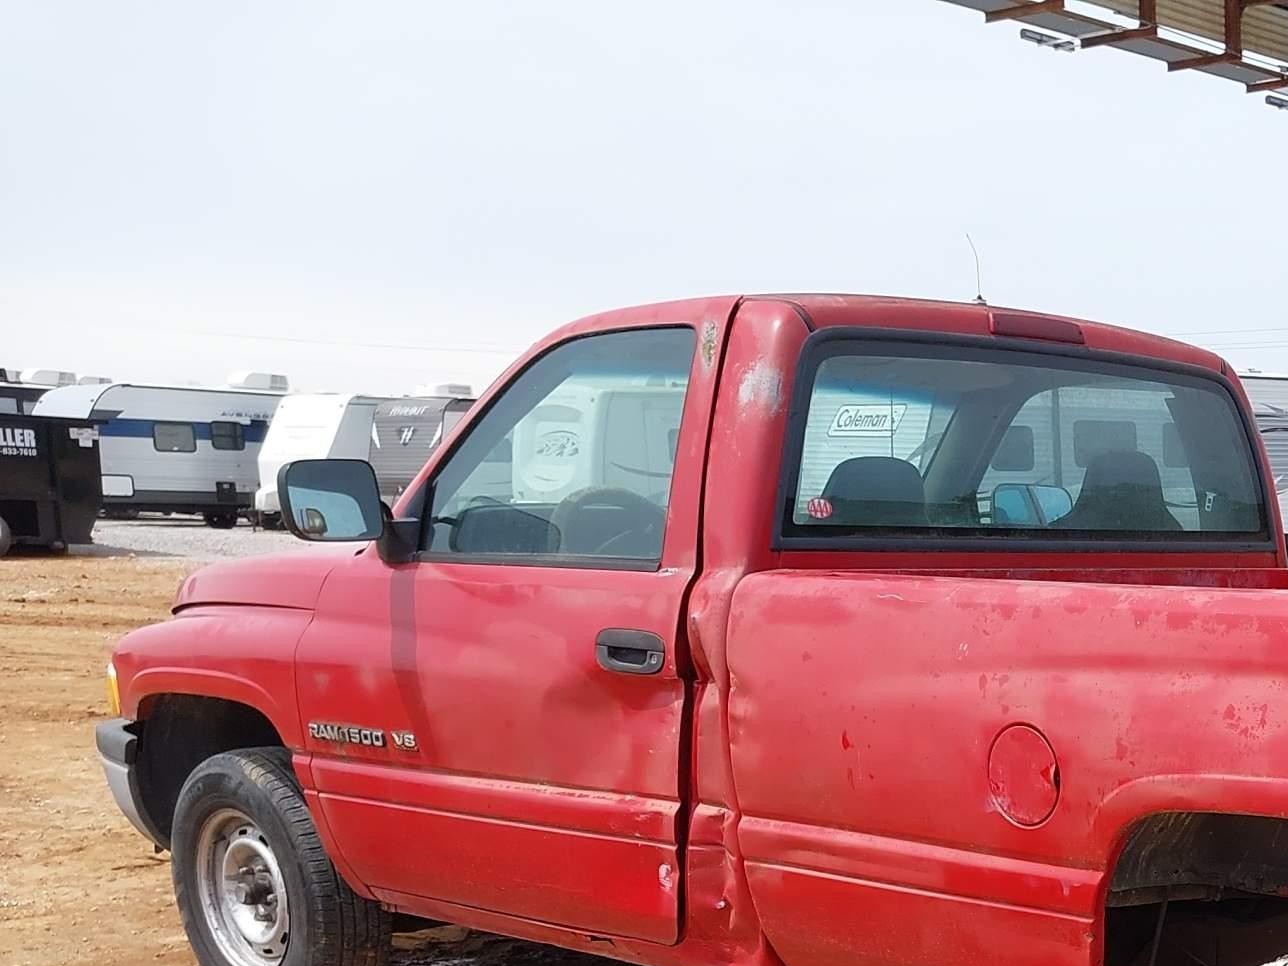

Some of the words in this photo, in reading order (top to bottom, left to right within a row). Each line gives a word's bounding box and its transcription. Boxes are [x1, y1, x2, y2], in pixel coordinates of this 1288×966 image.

[836, 408, 888, 428] Coleman
[308, 723, 341, 741] RAM
[343, 727, 385, 747] 1500
